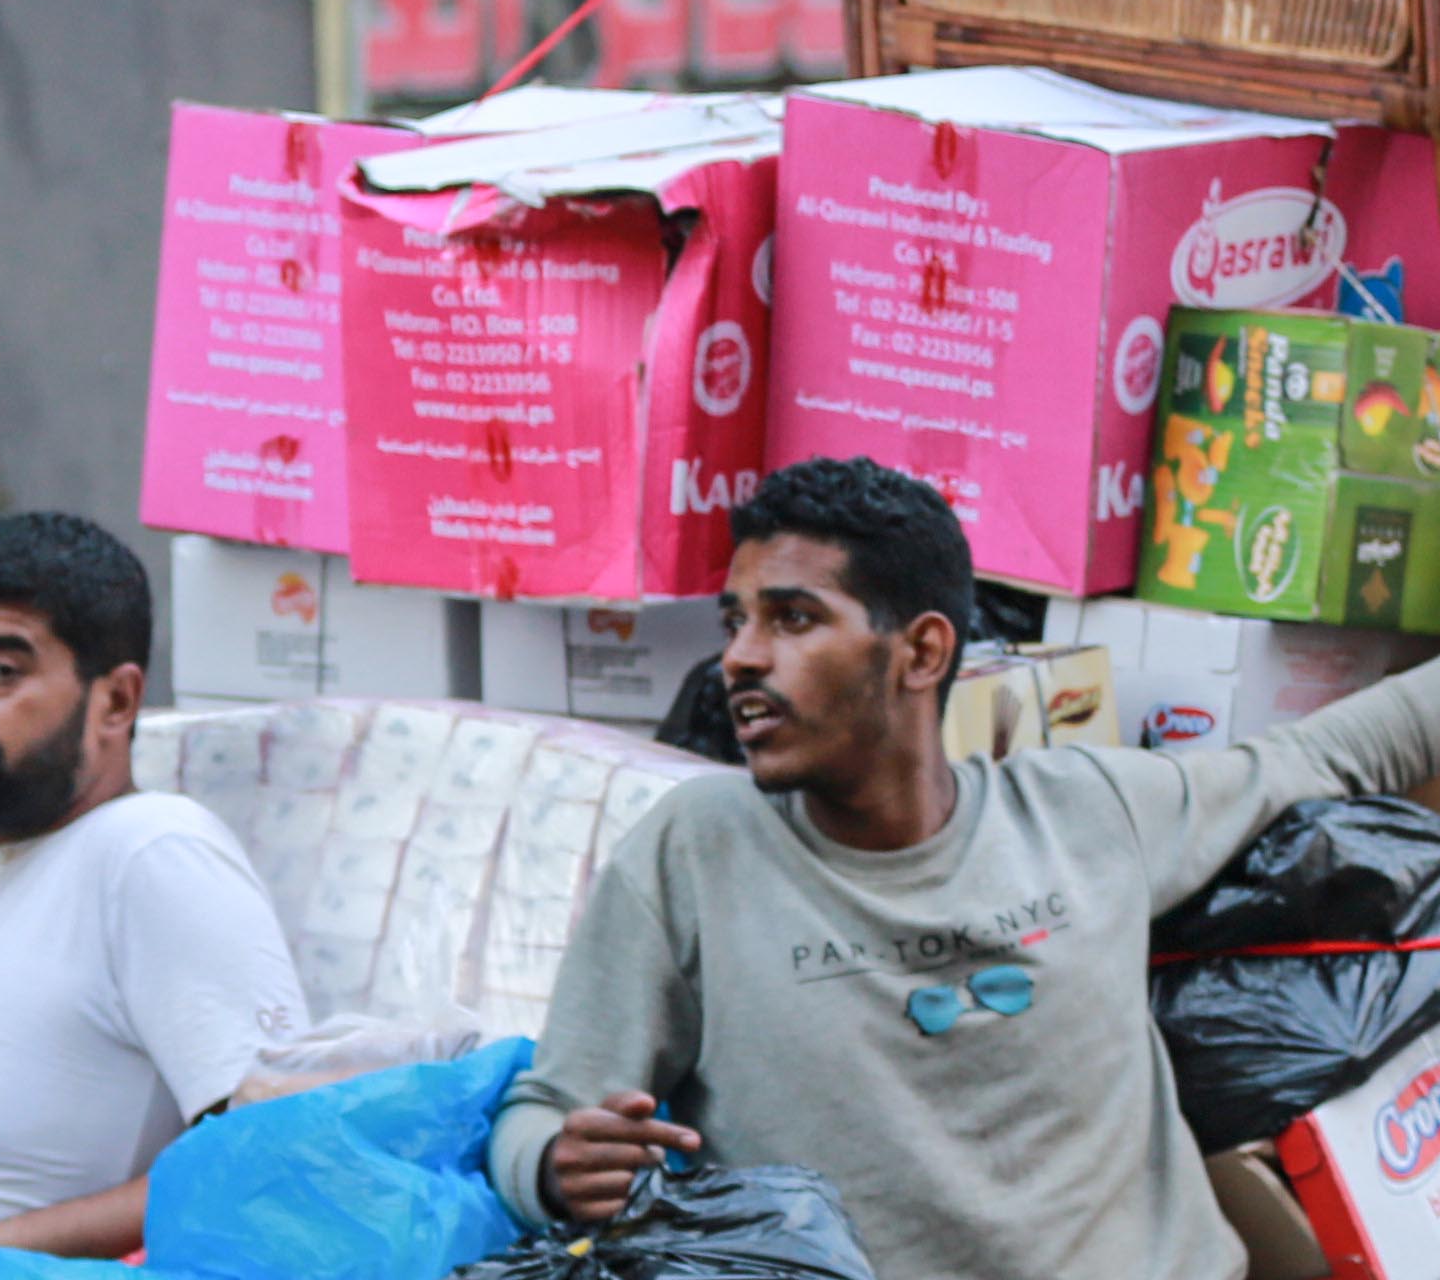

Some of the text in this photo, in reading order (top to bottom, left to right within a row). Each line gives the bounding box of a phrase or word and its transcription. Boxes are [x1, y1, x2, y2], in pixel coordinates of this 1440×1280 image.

[869, 175, 954, 211] Produced
[956, 190, 980, 220] By
[989, 226, 1053, 264] Trading
[987, 286, 1019, 312] 508
[538, 314, 578, 336] 508
[1265, 332, 1290, 442] Panda
